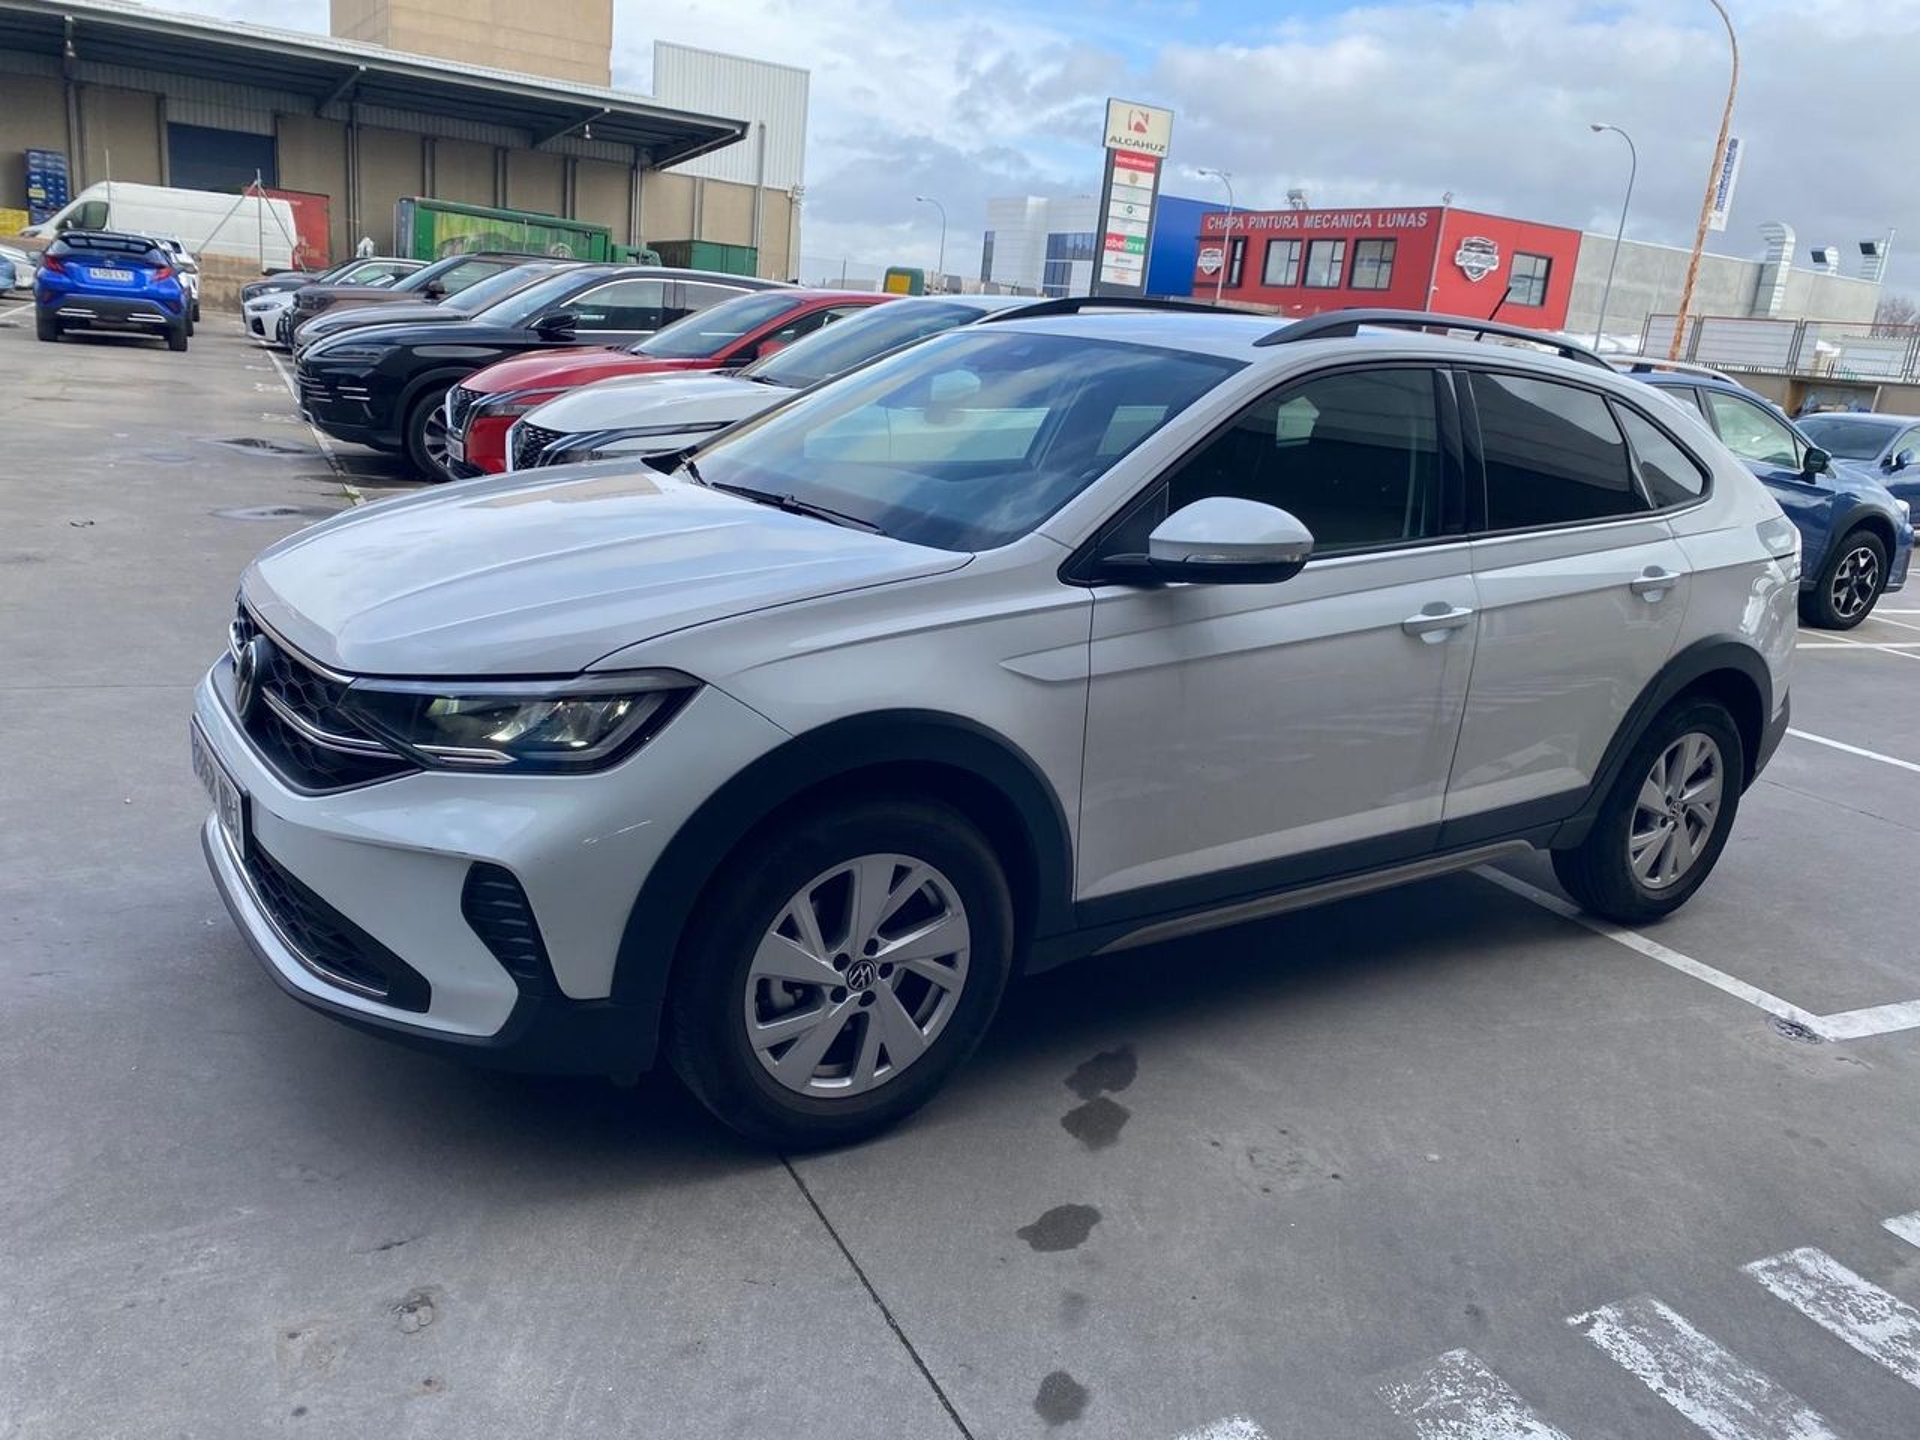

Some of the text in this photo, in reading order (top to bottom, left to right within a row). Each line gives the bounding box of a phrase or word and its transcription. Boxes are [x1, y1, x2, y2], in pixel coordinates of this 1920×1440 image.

[1109, 135, 1166, 152] ALCAHUZ
[1207, 211, 1428, 230] CHAPA PINTURA MECANICA LUNAS
